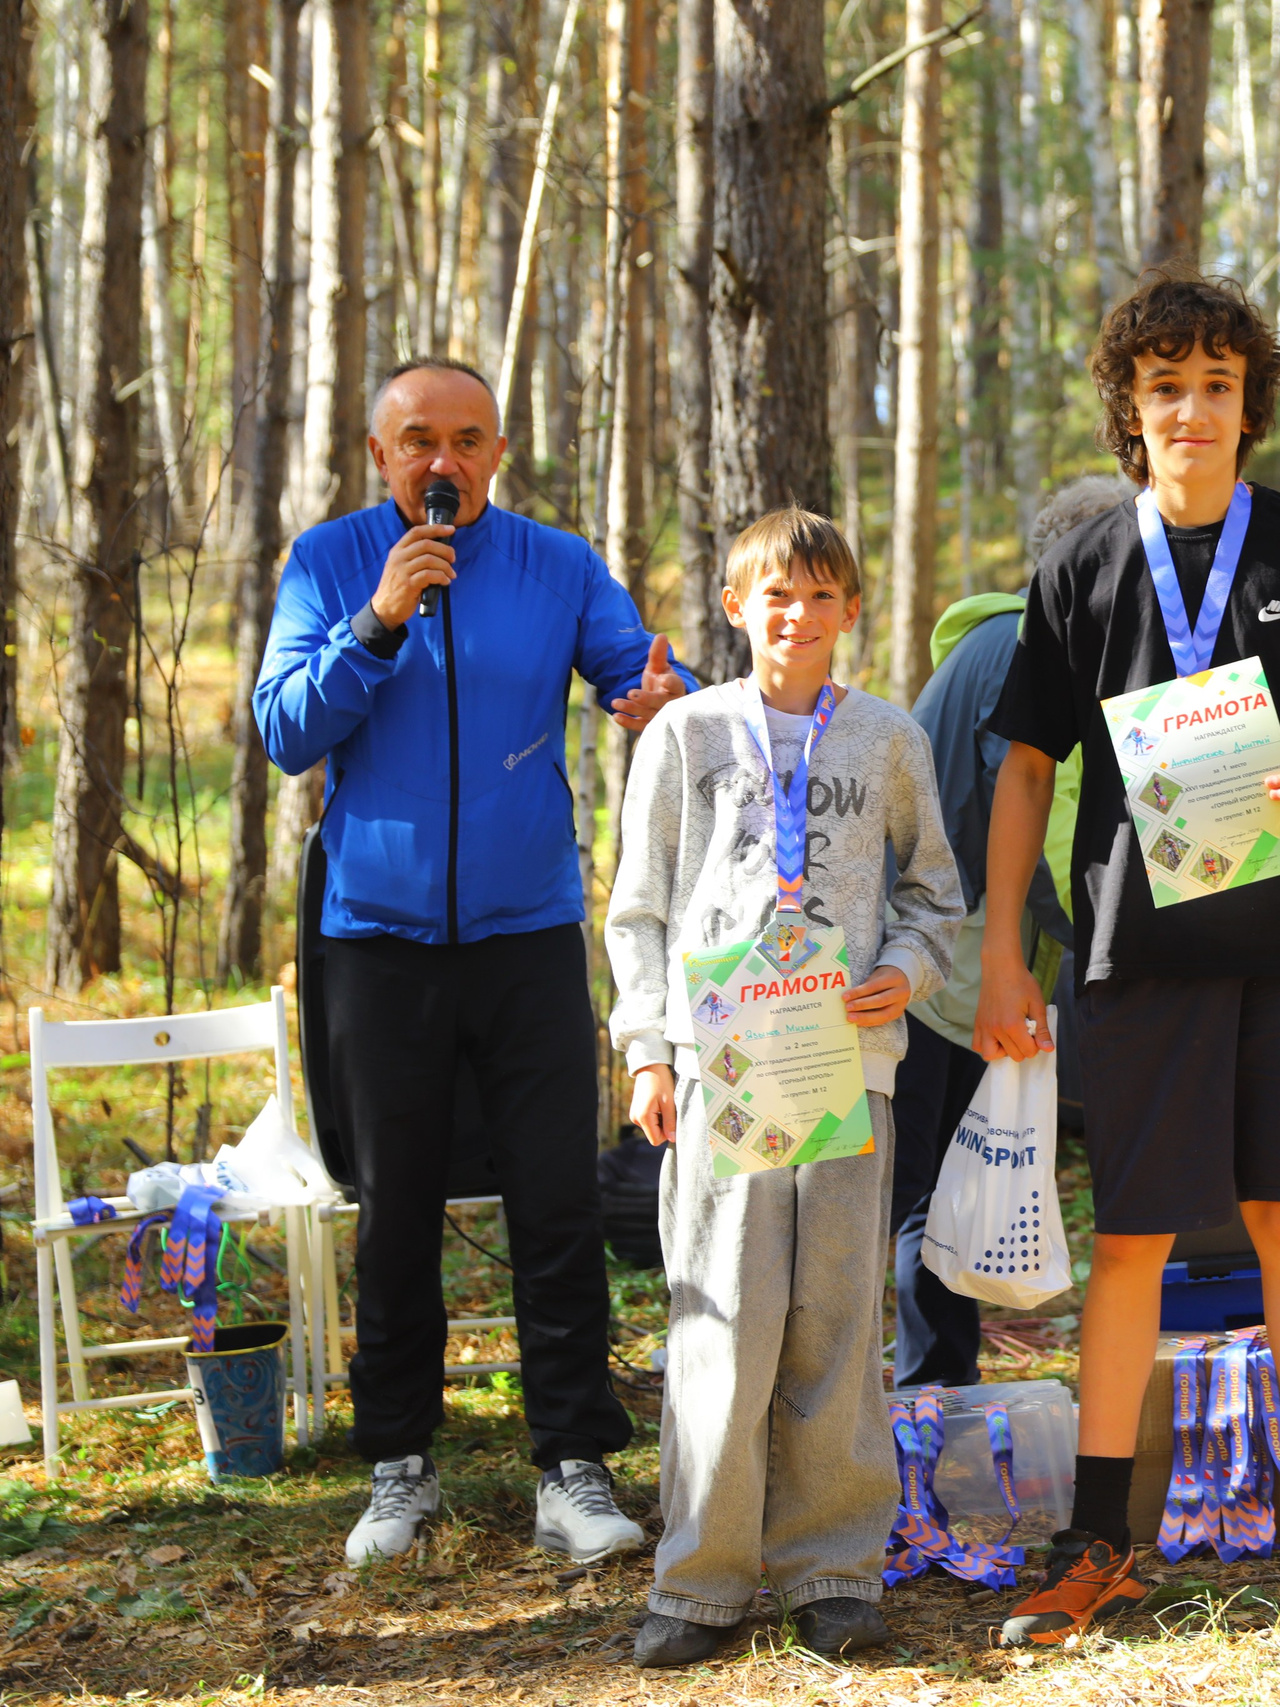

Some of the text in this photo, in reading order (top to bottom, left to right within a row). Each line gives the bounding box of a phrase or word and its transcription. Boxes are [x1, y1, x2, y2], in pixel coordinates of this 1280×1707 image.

[1163, 692, 1268, 733] ГРАМОТА
[1194, 723, 1247, 741] НАГРАЖДАЕТСЯ
[1229, 762, 1247, 770] место
[1196, 789, 1234, 803] спортивному
[1234, 780, 1265, 792] ориентиро
[1199, 775, 1241, 790] традиционных
[740, 970, 846, 1003] ГРАМОТА
[770, 1002, 822, 1015] НАГРАЖДАЕТСЯ
[769, 1054, 811, 1065] традиционных
[812, 1046, 855, 1058] соревнованиях
[765, 1067, 803, 1077] спортивному
[804, 1058, 852, 1071] ориентированию
[1260, 1366, 1276, 1413] ГОРНЫЙ
[1180, 1373, 1193, 1468] ГОРНЫЙ КОРОЛЬ
[1213, 1418, 1229, 1461] КОРОЛЬ
[1230, 1413, 1243, 1458] КОРОЛЬ
